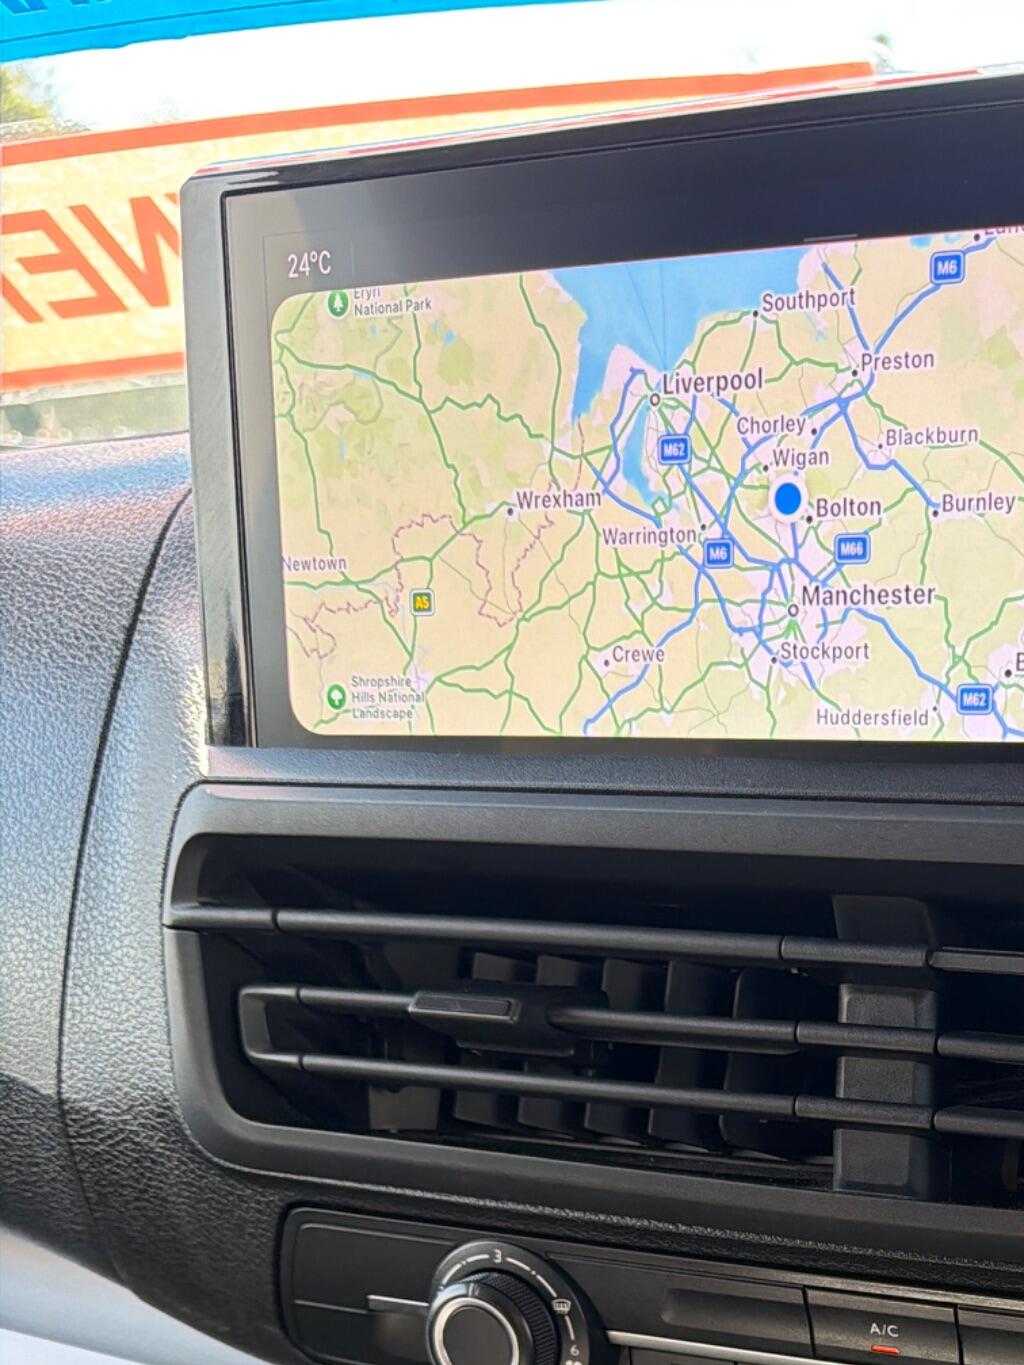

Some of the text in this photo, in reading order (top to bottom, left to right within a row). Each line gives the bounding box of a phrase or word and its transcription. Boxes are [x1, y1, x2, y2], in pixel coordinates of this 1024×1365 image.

[287, 250, 332, 278] 24°C
[937, 260, 958, 276] M6
[354, 298, 432, 316] National Park
[762, 289, 856, 314] Southport
[861, 353, 935, 372] Preston
[663, 368, 763, 400] Liverpool
[737, 418, 806, 437] Chorley
[886, 429, 979, 447] Blackburn
[663, 442, 687, 458] M62
[773, 450, 830, 471] Wigan
[517, 490, 602, 510] Wrexham
[817, 497, 882, 518] Bolton
[942, 494, 1016, 514] Burnley
[603, 526, 697, 549] Warrington
[709, 546, 728, 562] M6
[840, 541, 864, 556] M66
[283, 556, 346, 571] Newtown
[415, 595, 430, 609] A5
[802, 584, 936, 608] Manchester
[613, 645, 665, 664] Crewe
[780, 642, 869, 663] Stockport
[352, 675, 412, 691] Shropshire
[352, 692, 424, 704] Hills National
[963, 692, 987, 707] M62
[352, 707, 413, 722] Landscape
[817, 709, 929, 727] Huddersfield
[492, 1250, 503, 1263] 3
[870, 1322, 899, 1337] A/C
[571, 1345, 580, 1356] 6
